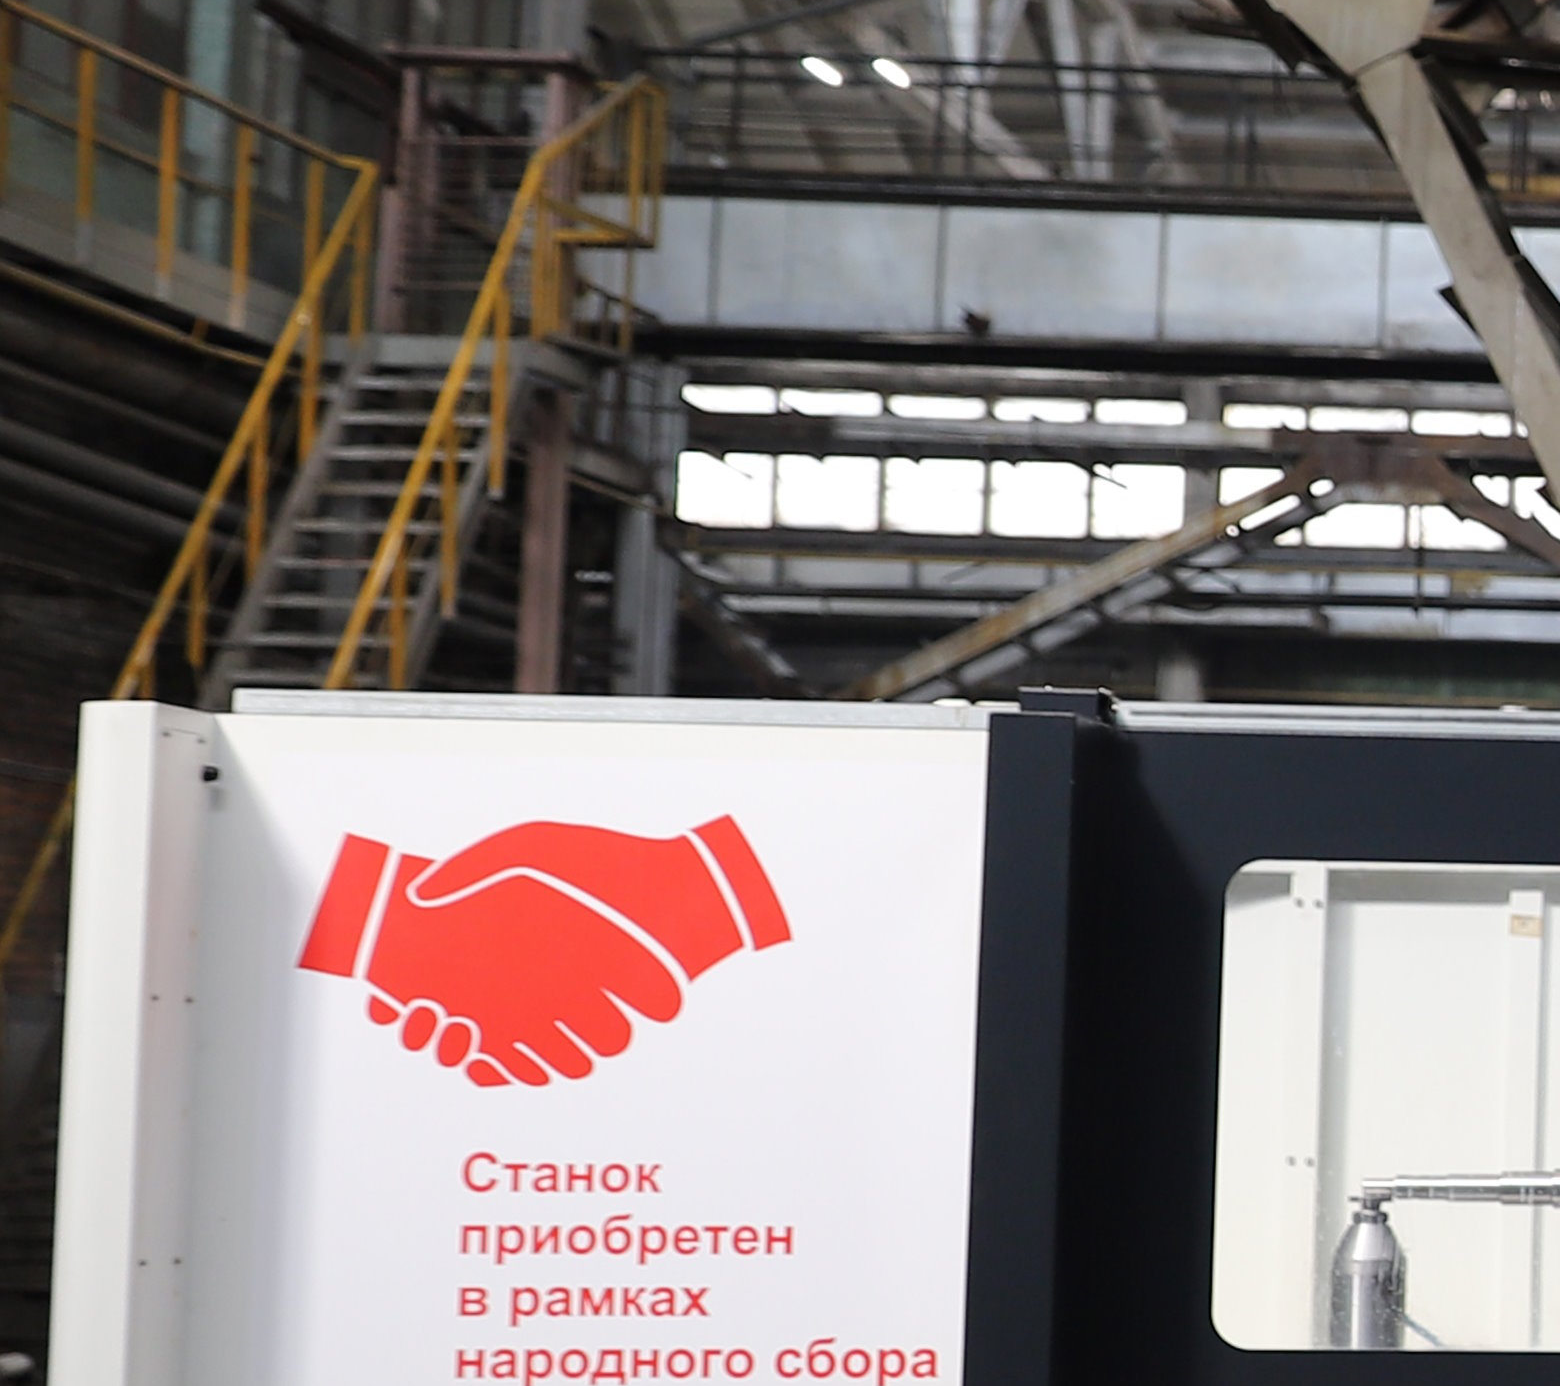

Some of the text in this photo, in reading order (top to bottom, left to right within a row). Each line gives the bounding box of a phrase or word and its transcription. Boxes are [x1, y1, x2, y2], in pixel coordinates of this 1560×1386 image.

[462, 1151, 661, 1193] Станок
[459, 1213, 794, 1265] приобретен
[457, 1286, 710, 1326] в рамках
